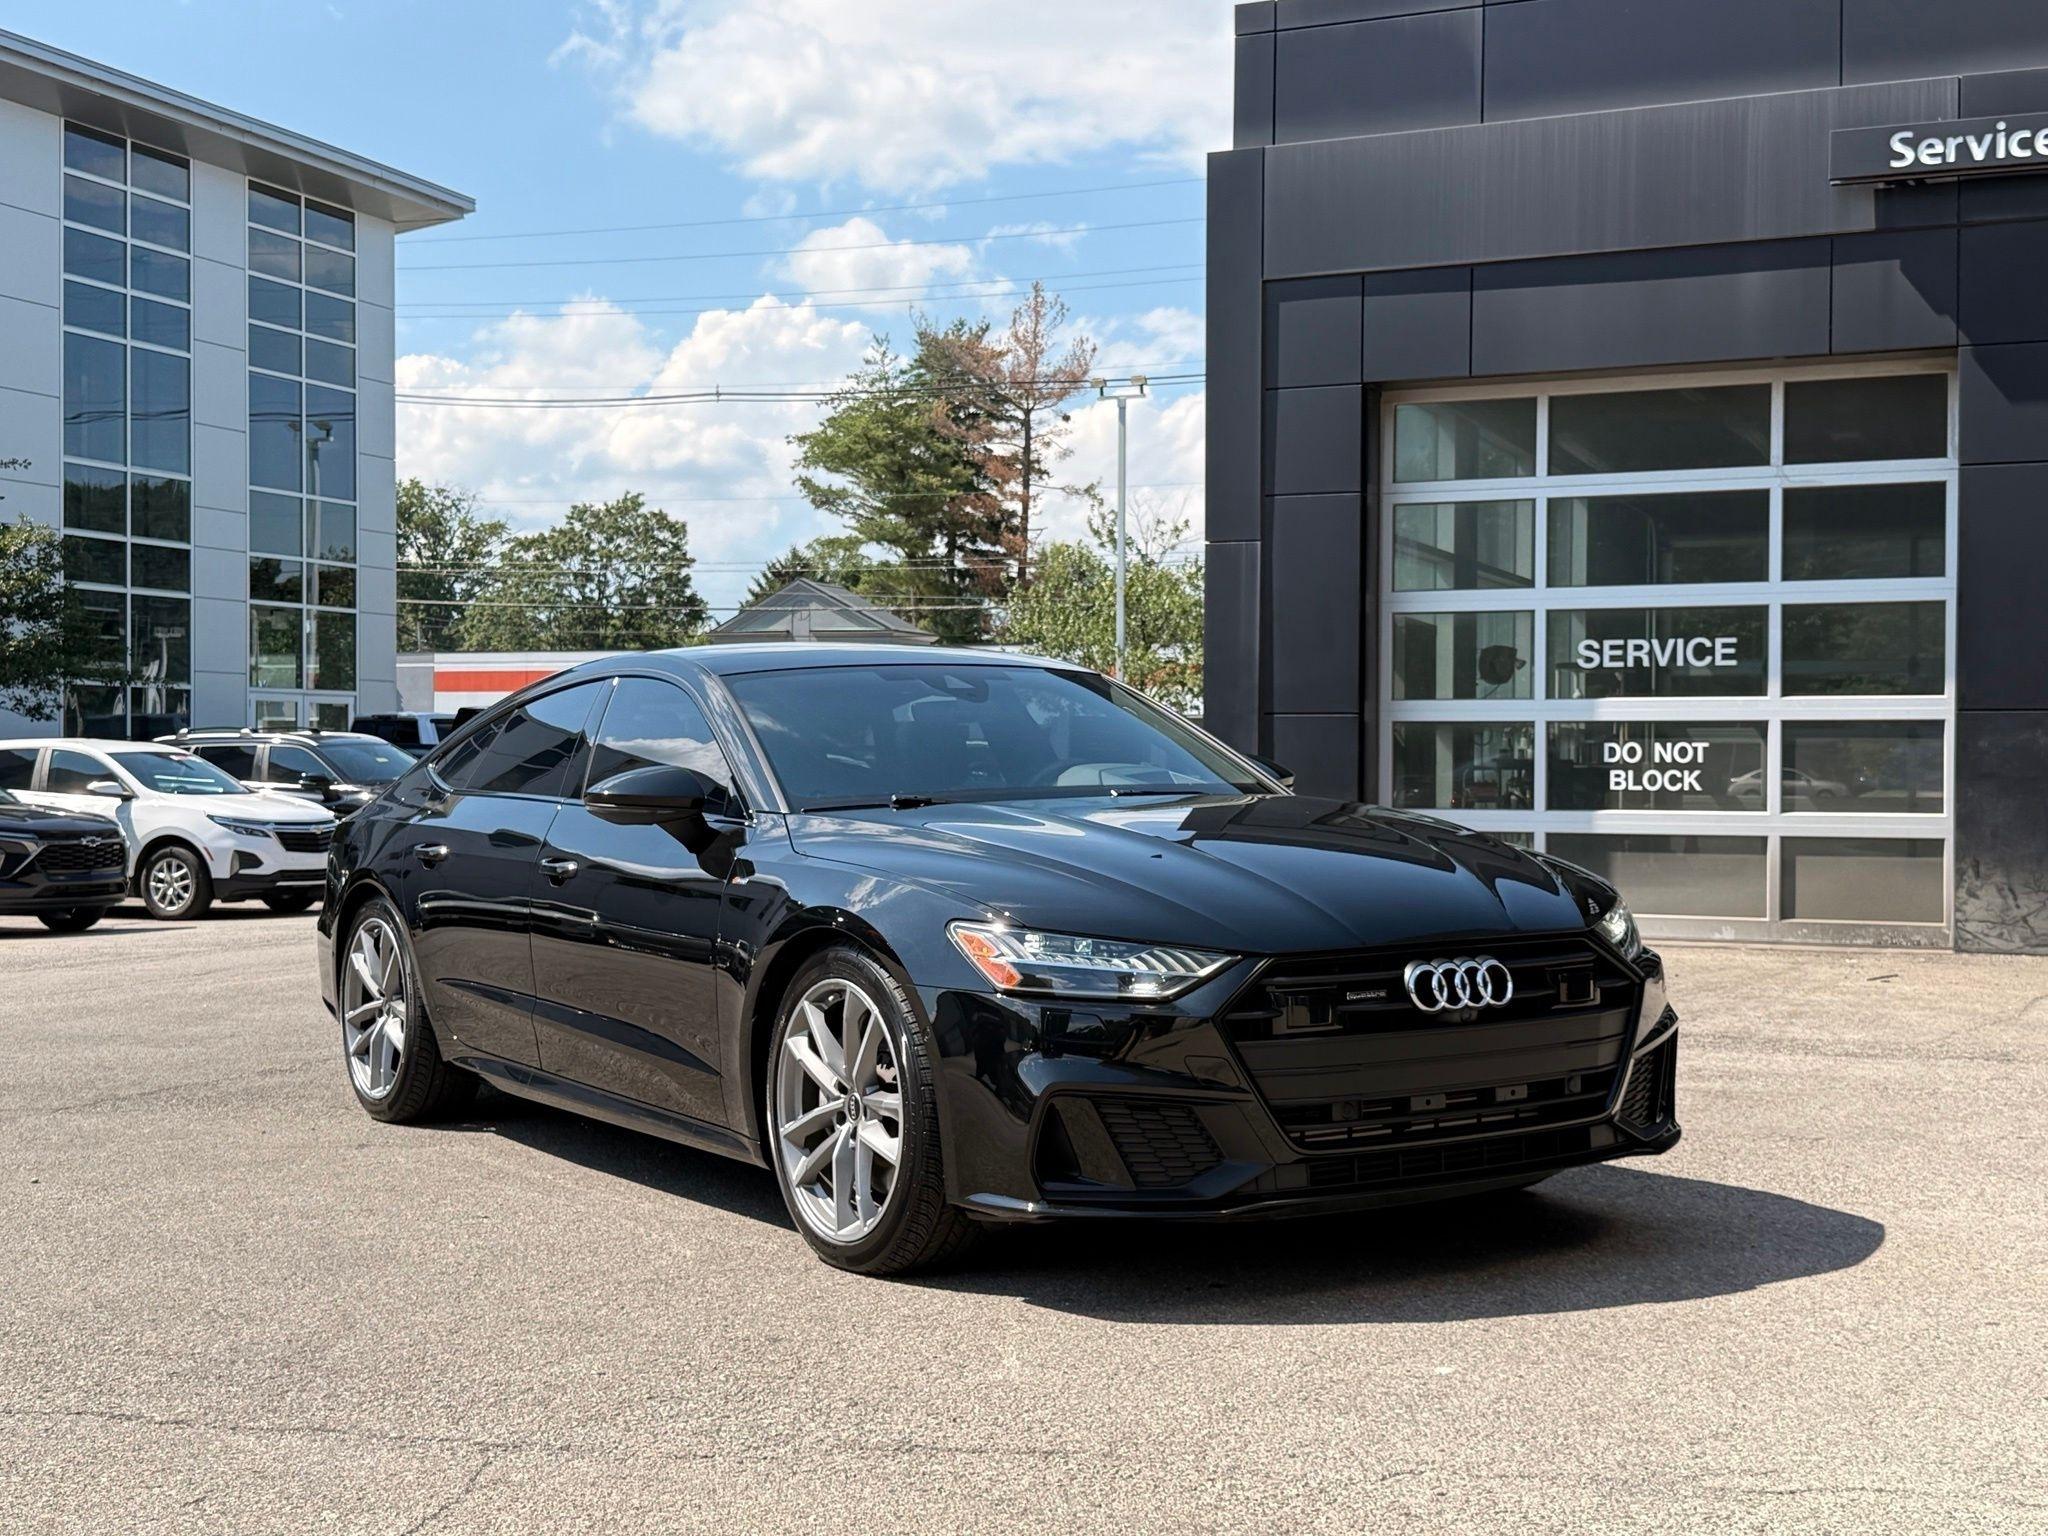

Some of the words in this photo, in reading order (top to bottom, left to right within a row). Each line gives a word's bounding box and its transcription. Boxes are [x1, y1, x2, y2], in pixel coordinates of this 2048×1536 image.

[1576, 637, 1738, 669] SERVICE
[1603, 741, 1643, 764] DO
[1654, 741, 1710, 764] NOT
[1609, 769, 1703, 792] BLOCK
